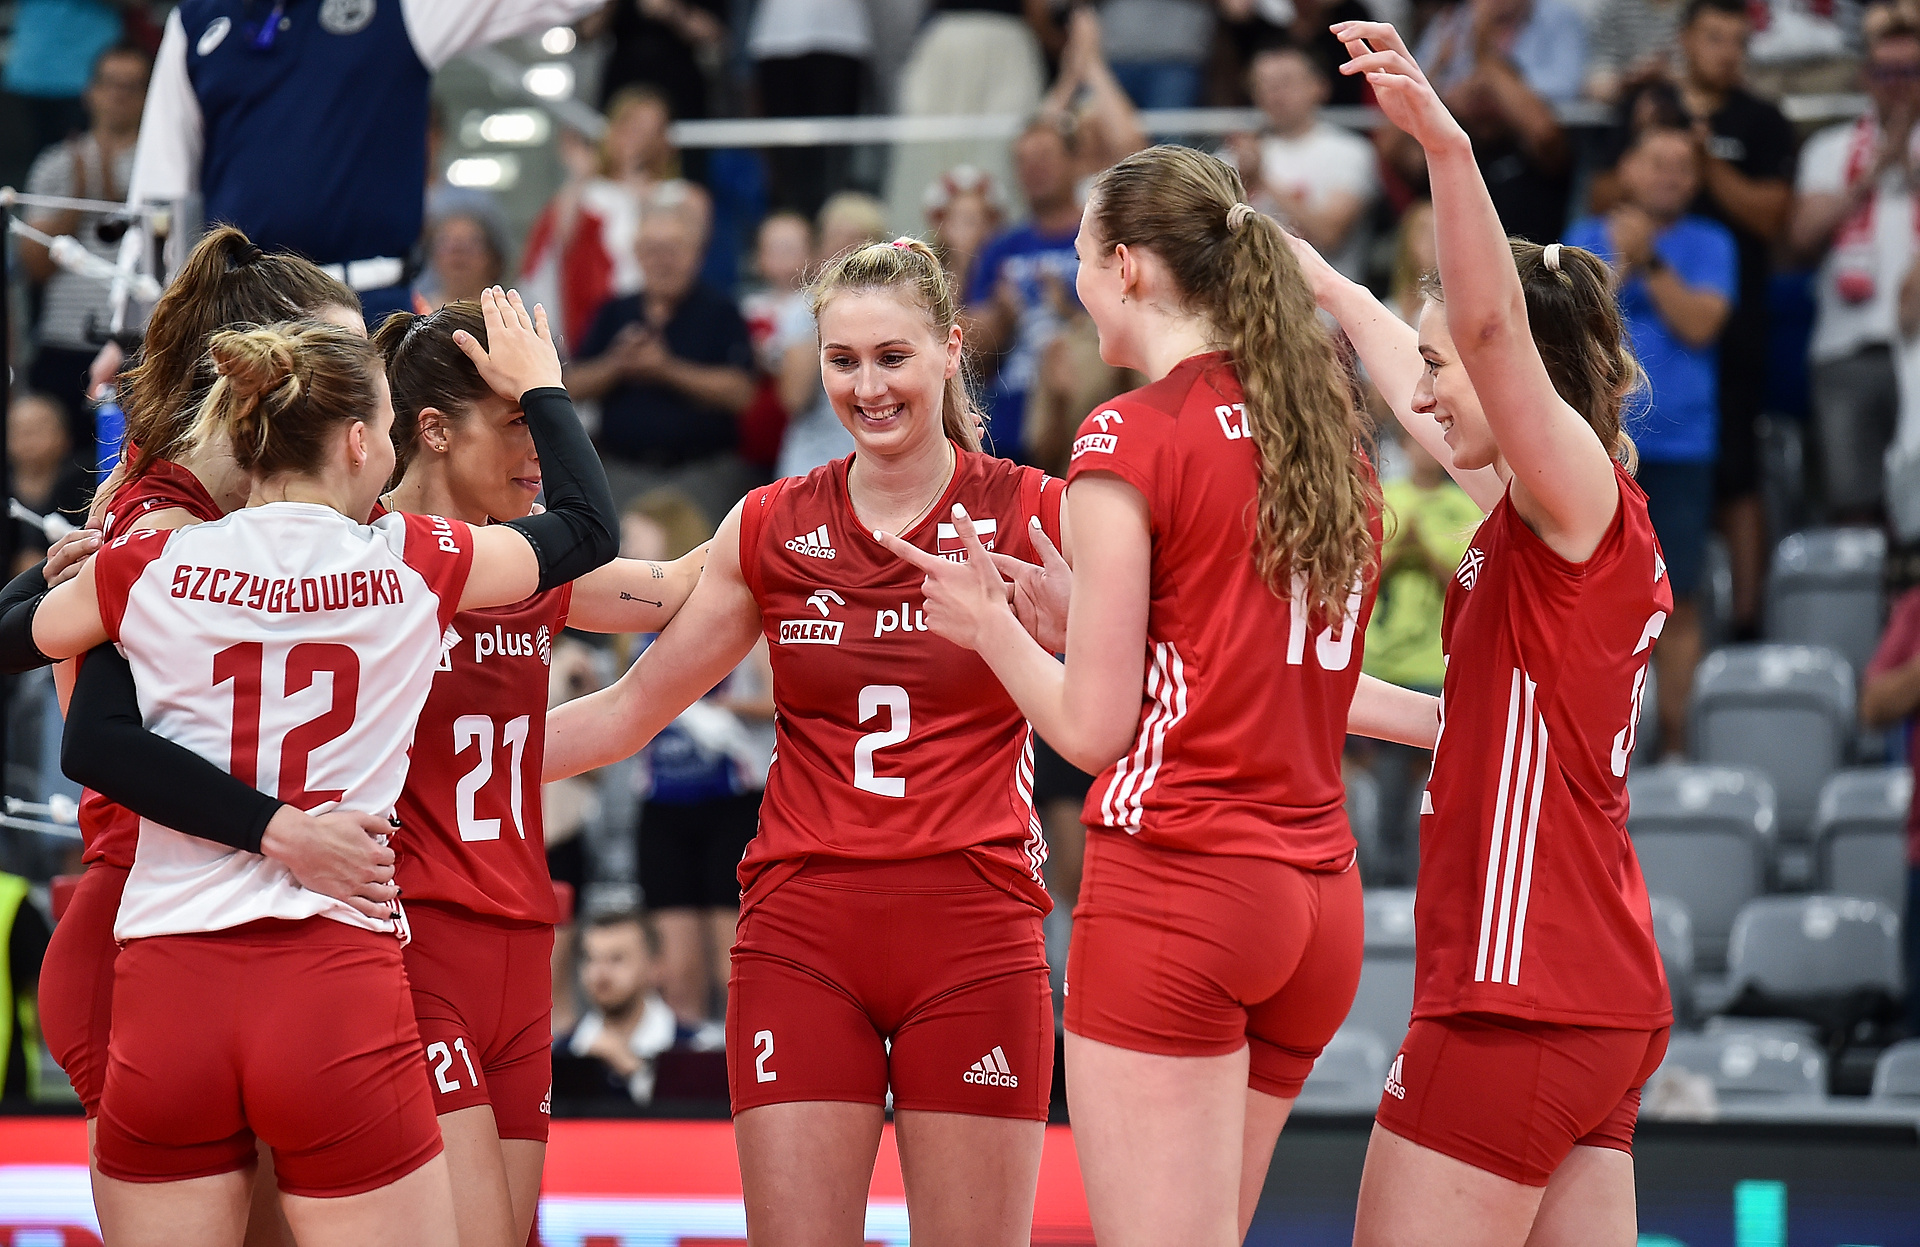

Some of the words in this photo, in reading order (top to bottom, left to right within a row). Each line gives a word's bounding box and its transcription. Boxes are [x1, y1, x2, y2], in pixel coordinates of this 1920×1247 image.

[785, 538, 837, 560] adidas
[170, 564, 404, 614] SZCZYGŁOWSKA
[474, 624, 534, 664] plus
[781, 623, 838, 641] ORLEN
[873, 602, 929, 638] plu
[212, 641, 361, 812] 12
[853, 685, 911, 798] 2
[453, 714, 530, 842] 21
[427, 1037, 479, 1094] 21
[754, 1029, 777, 1084] 2
[963, 1069, 1019, 1088] adidas
